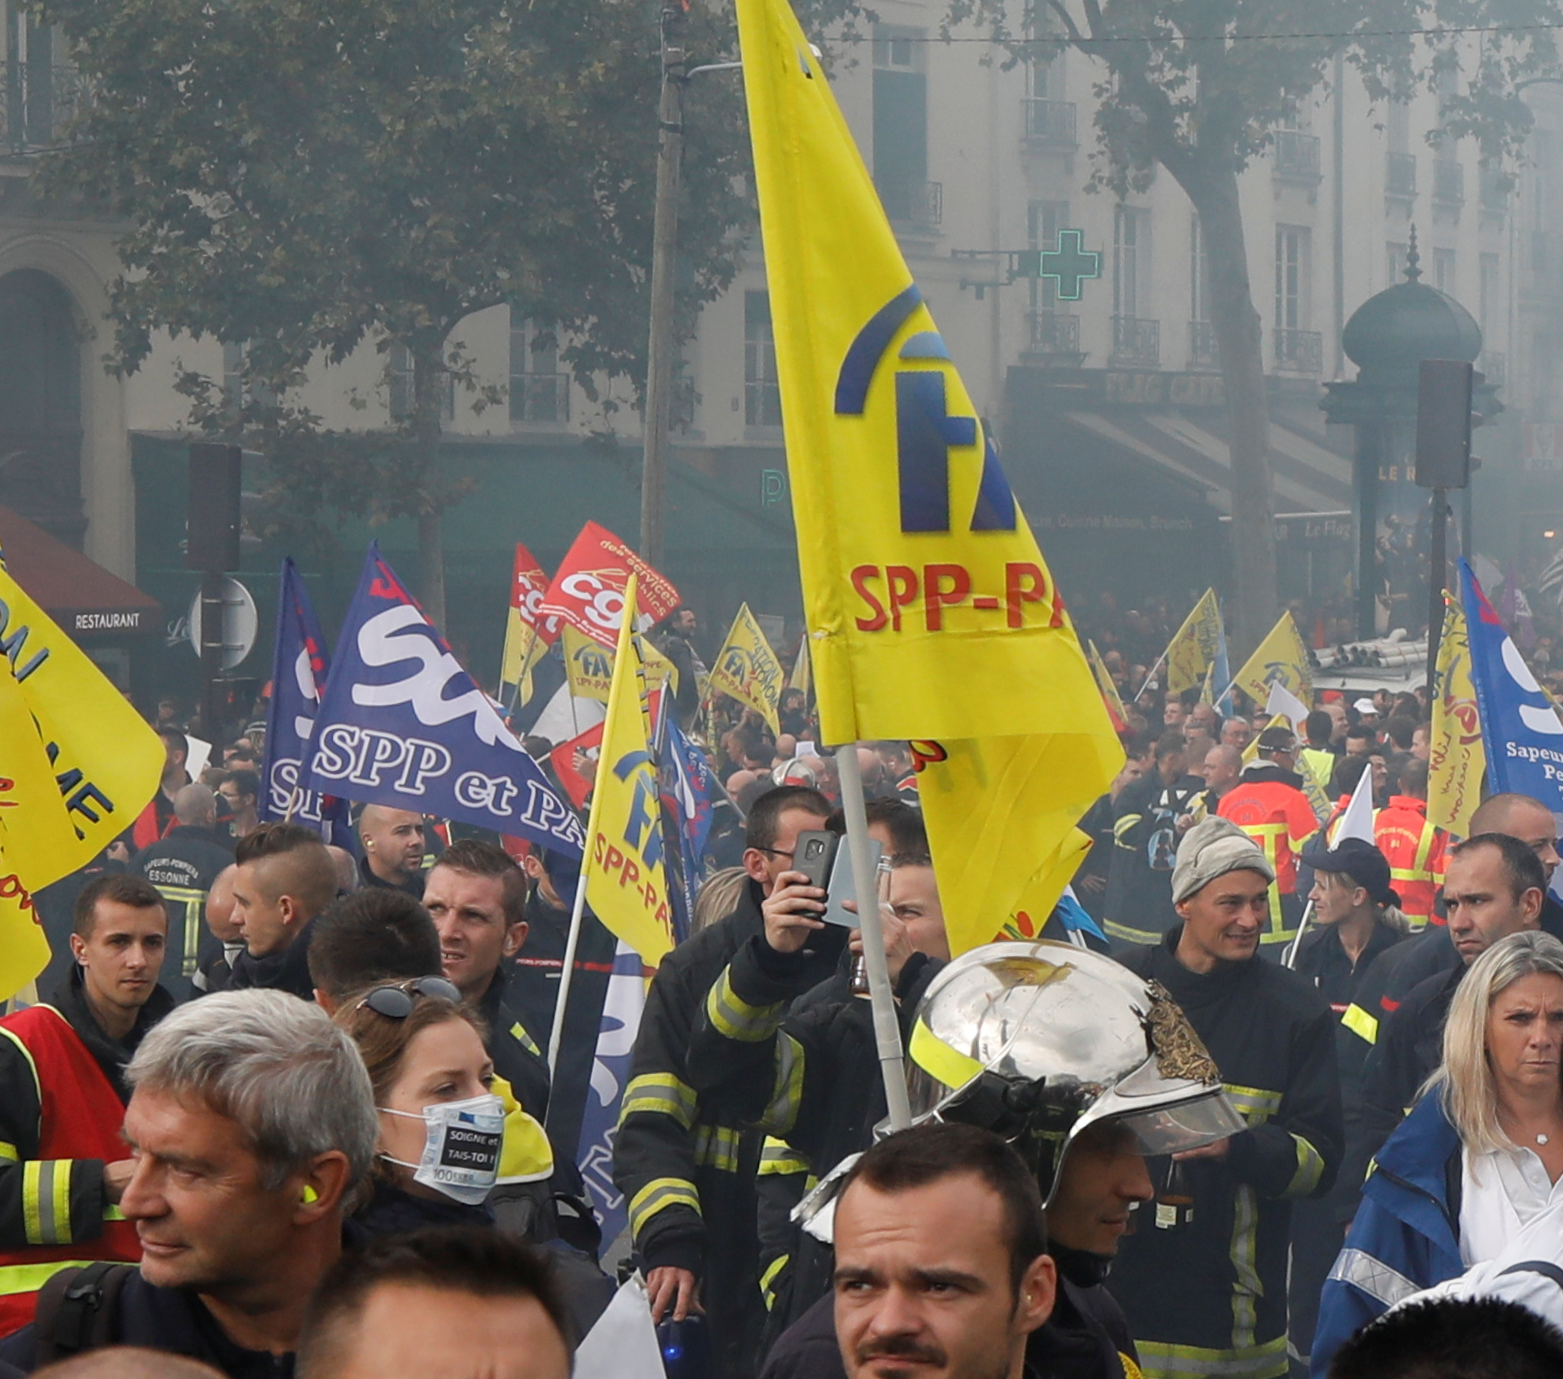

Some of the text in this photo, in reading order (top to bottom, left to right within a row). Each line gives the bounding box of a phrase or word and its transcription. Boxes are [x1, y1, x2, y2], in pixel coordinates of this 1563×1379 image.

[75, 612, 140, 630] RESTAURANT
[311, 723, 450, 797] SPP
[455, 766, 519, 817] et
[148, 869, 190, 886] ESSONNE
[450, 1130, 498, 1147] SOIGNE et
[448, 1149, 489, 1164] TAIS-TOI
[433, 1168, 453, 1182] 100
